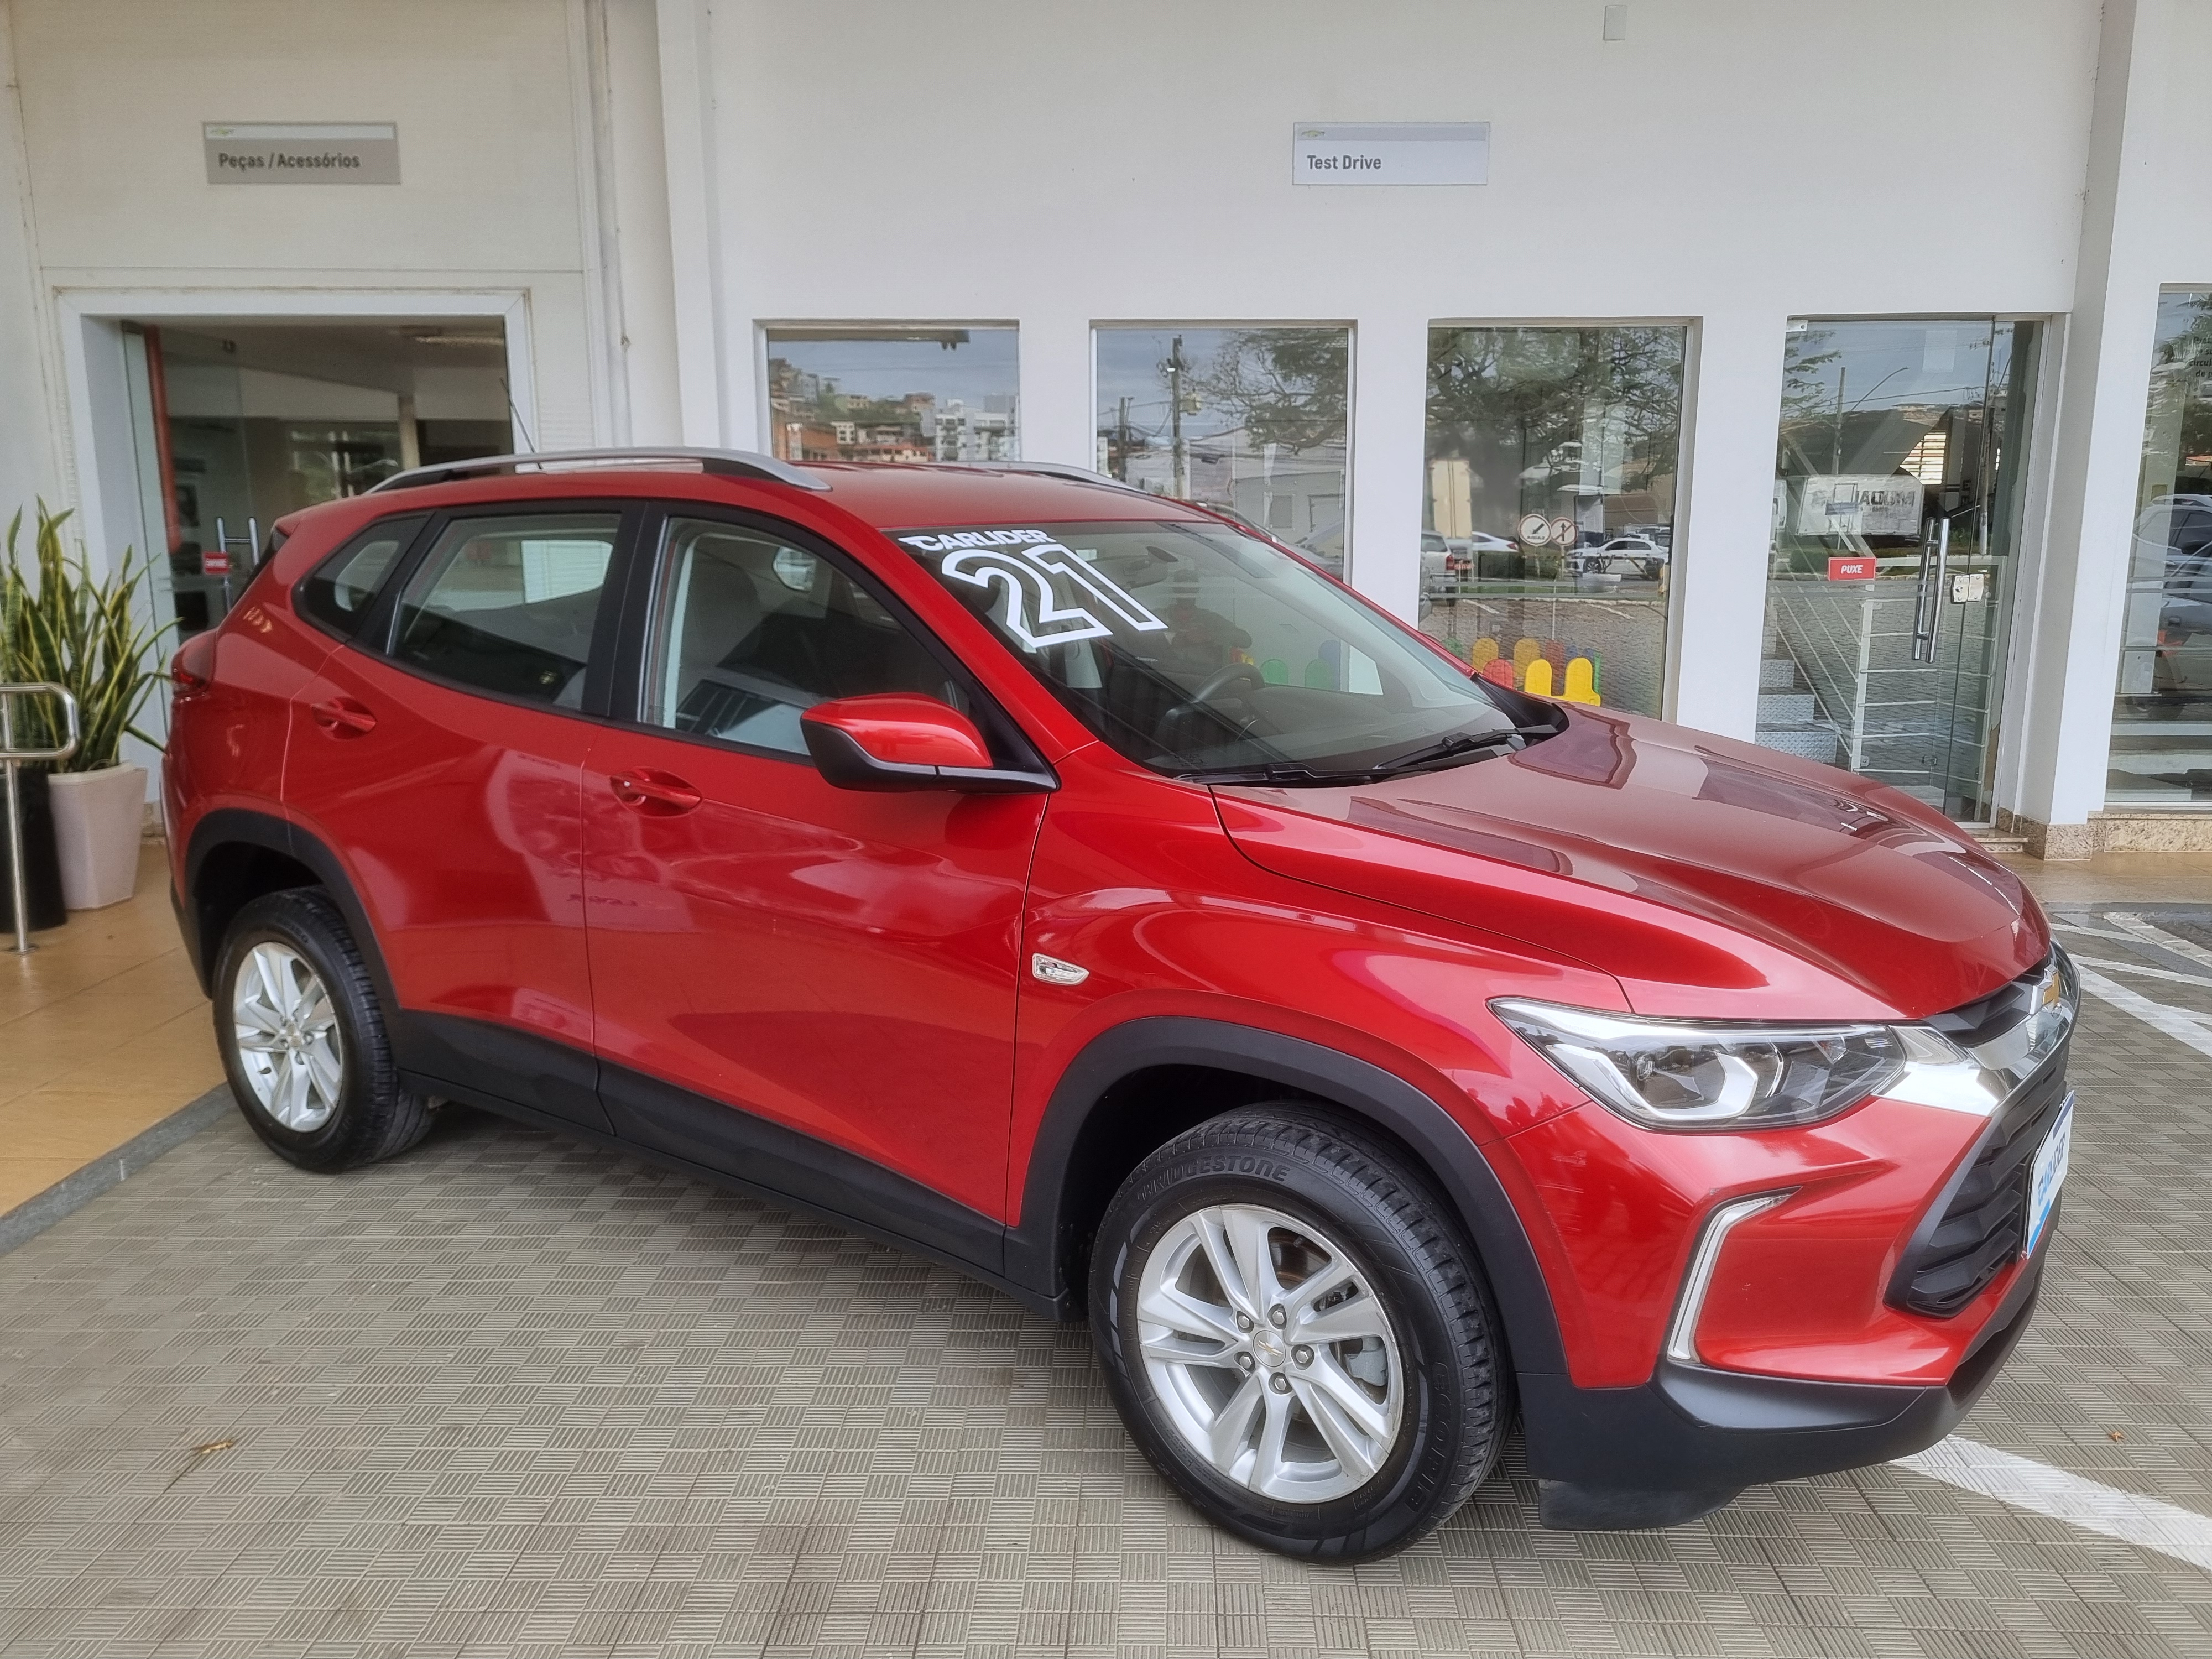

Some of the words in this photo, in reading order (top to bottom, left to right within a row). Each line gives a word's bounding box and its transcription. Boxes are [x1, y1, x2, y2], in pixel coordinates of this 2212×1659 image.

[218, 152, 265, 172] Peças
[277, 152, 361, 169] Acessórios
[1306, 154, 1338, 170] Test
[1342, 154, 1382, 170] Drive
[898, 529, 1057, 551] CARLIDER
[1840, 565, 1864, 575] PUXE
[941, 544, 1169, 649] 21
[1136, 1155, 1291, 1201] BRIDGESTONE
